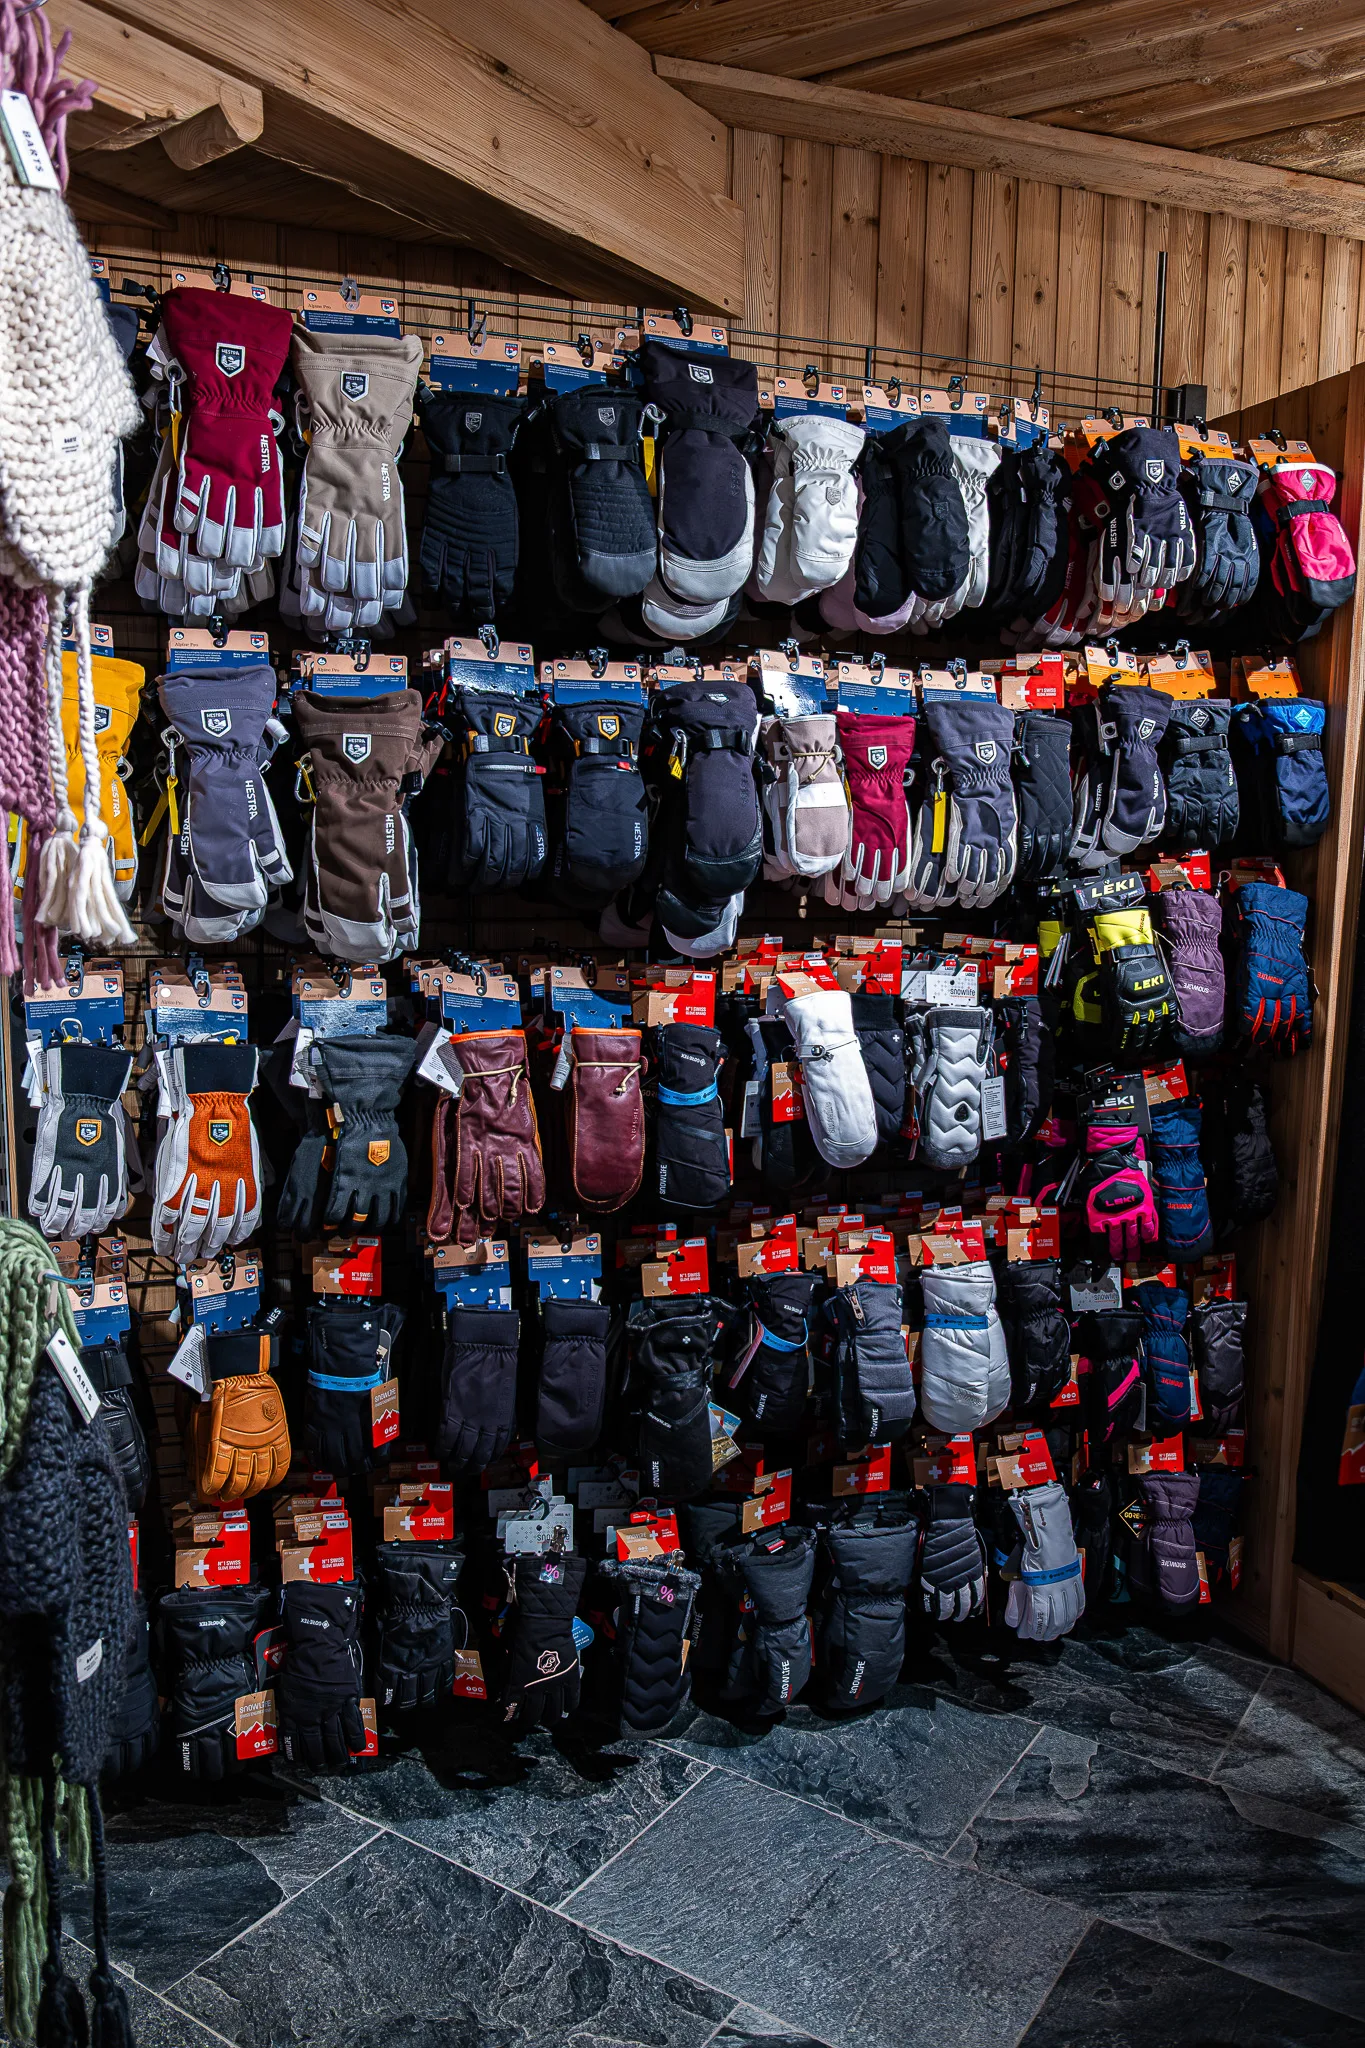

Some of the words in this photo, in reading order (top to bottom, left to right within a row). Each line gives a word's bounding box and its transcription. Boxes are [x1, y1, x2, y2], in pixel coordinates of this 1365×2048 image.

[260, 434, 271, 473] HESTRA
[381, 463, 391, 501] HESTRA
[1178, 501, 1186, 530] HESTRA
[1064, 561, 1075, 589] HESTRA
[112, 779, 120, 817] HESTRA
[245, 779, 258, 820] HESTRA
[181, 817, 189, 855] HESTRA
[385, 814, 394, 854] HESTRA
[1092, 878, 1134, 898] LEKI
[950, 988, 975, 996] snowlife
[1134, 975, 1163, 990] LEKI
[1183, 983, 1209, 993] SNOWLIFE
[1092, 1096, 1134, 1107] LEKI
[1105, 1195, 1134, 1206] LEKI
[267, 1307, 280, 1324] HES
[73, 1366, 92, 1401] BARTS
[374, 1388, 396, 1402] SNOWLIFE
[781, 1660, 789, 1699] SNOWLIFE
[850, 1660, 865, 1694] SNOWLIFE
[239, 1700, 271, 1713] SNOWLIFE
